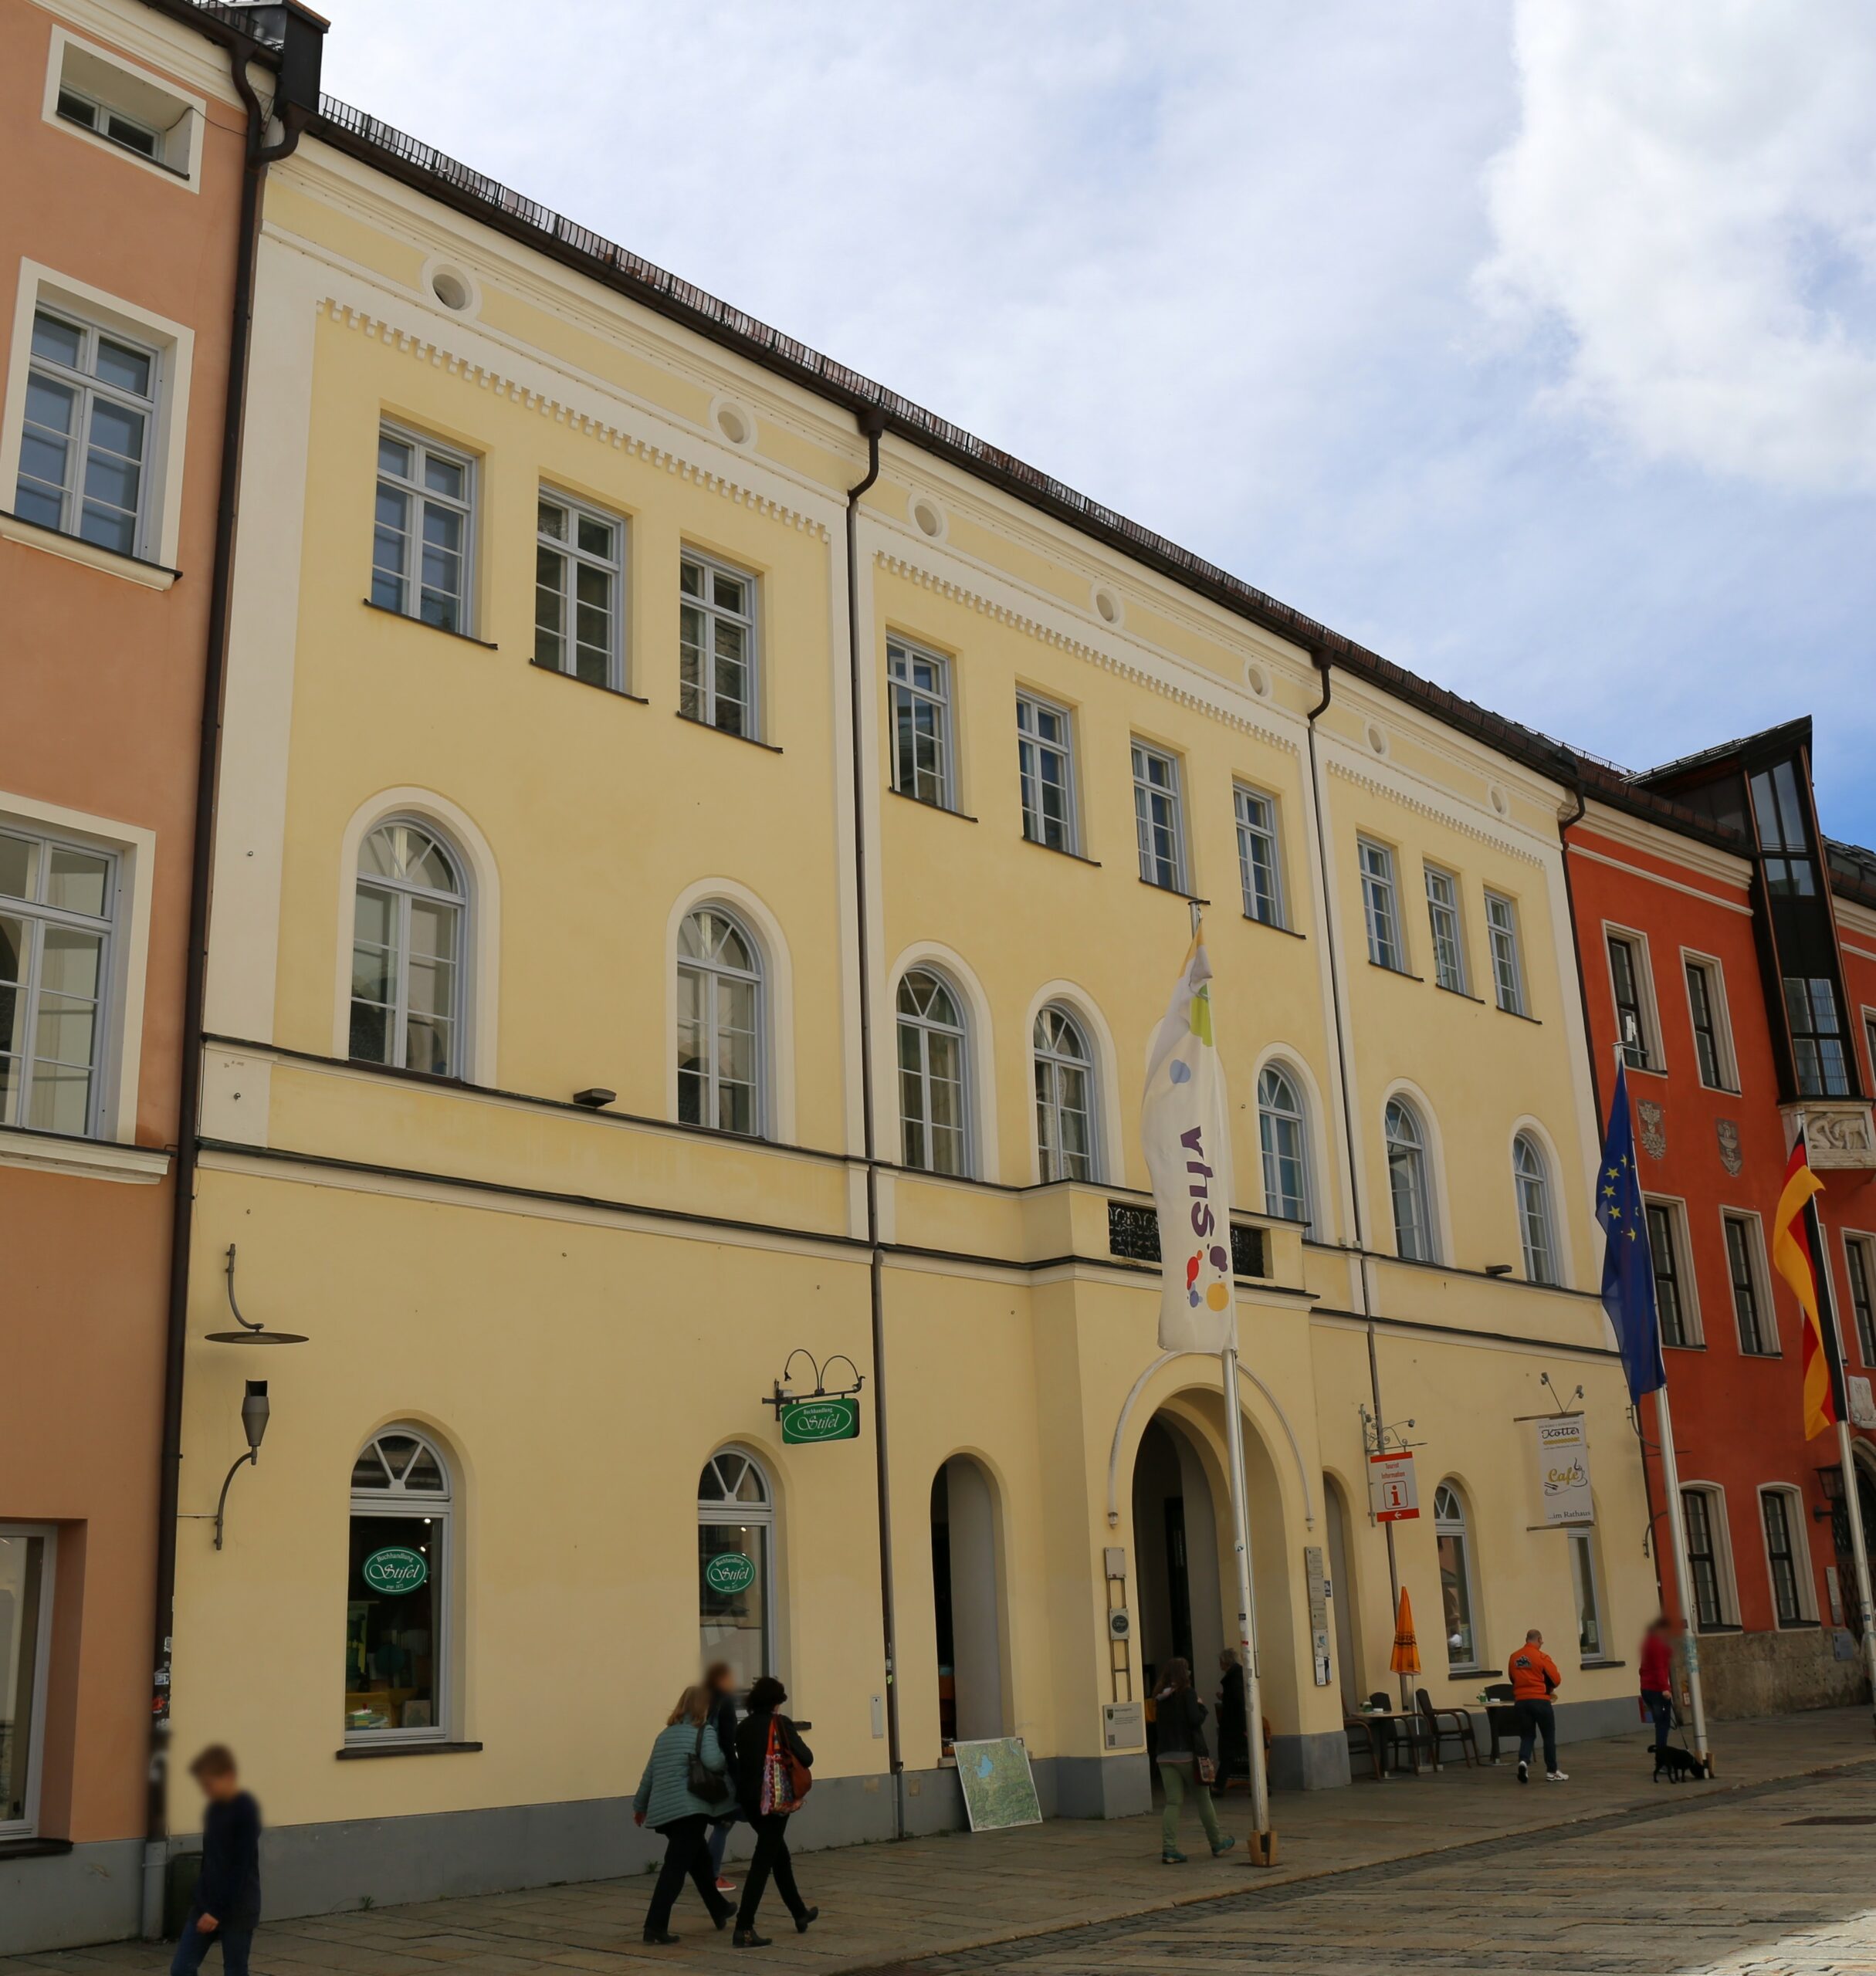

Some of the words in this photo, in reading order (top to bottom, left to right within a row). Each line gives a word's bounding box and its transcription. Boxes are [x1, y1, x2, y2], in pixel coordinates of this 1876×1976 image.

[1180, 1125, 1215, 1238] vhs
[797, 1413, 840, 1434] Stifel
[1563, 1510, 1591, 1518] Rathaus
[376, 1552, 414, 1563] Buchhandlung
[369, 1564, 421, 1584] Stifel
[710, 1567, 750, 1585] Stifel
